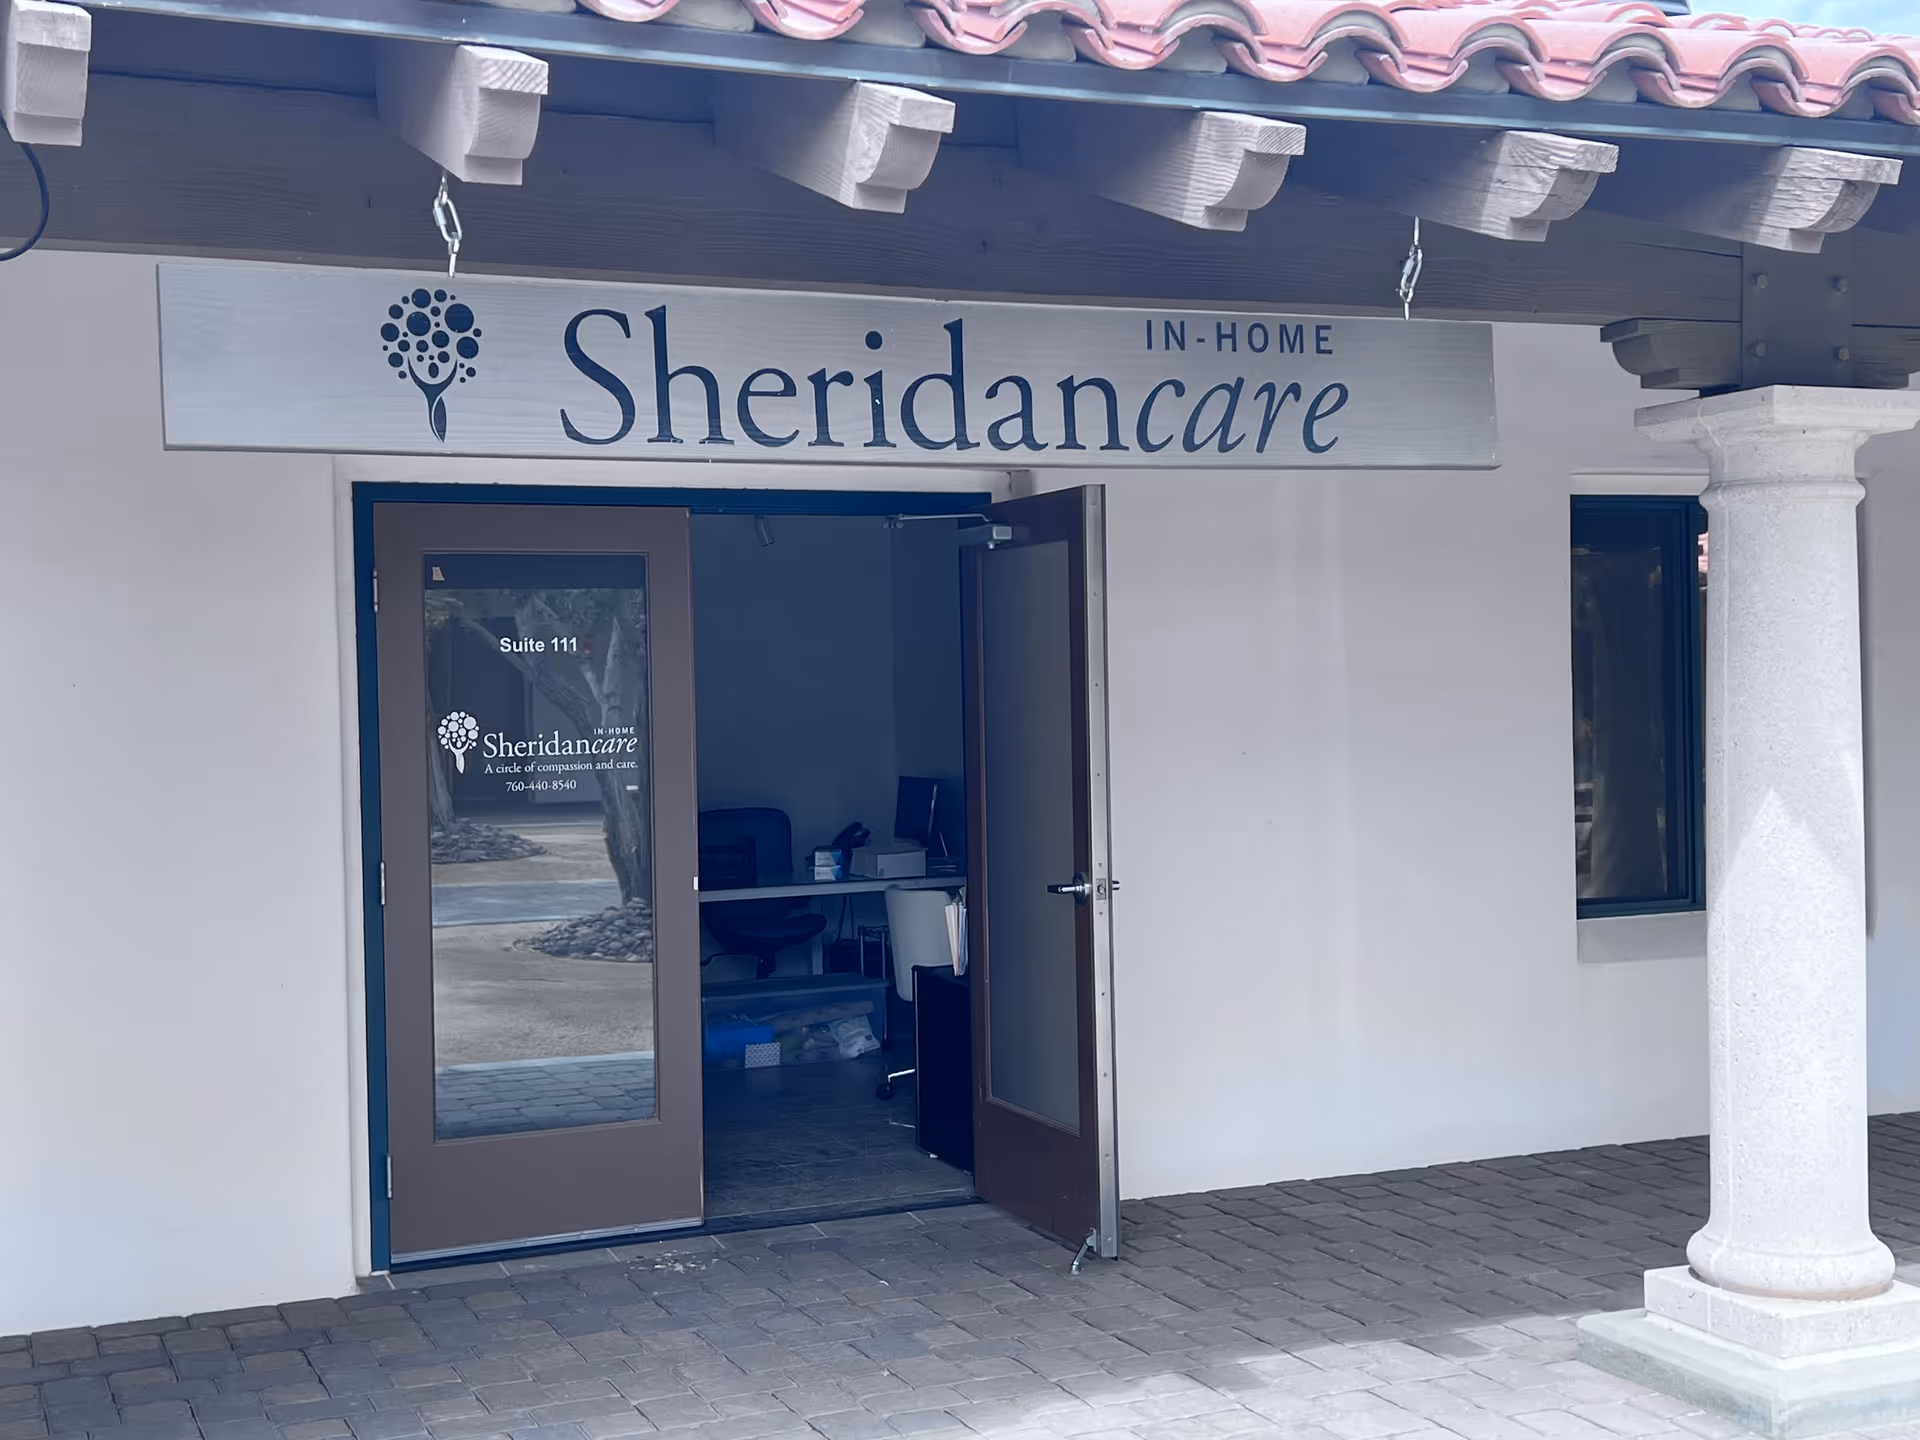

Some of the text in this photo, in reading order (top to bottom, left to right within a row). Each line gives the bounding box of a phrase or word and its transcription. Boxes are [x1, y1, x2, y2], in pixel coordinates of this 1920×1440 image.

[1145, 319, 1334, 355] IN-HOME
[499, 637, 577, 653] Suite 111
[593, 727, 635, 735] IN-HOME
[484, 759, 638, 774] A circle of compassion and care.
[505, 779, 577, 792] 760-440-8540
